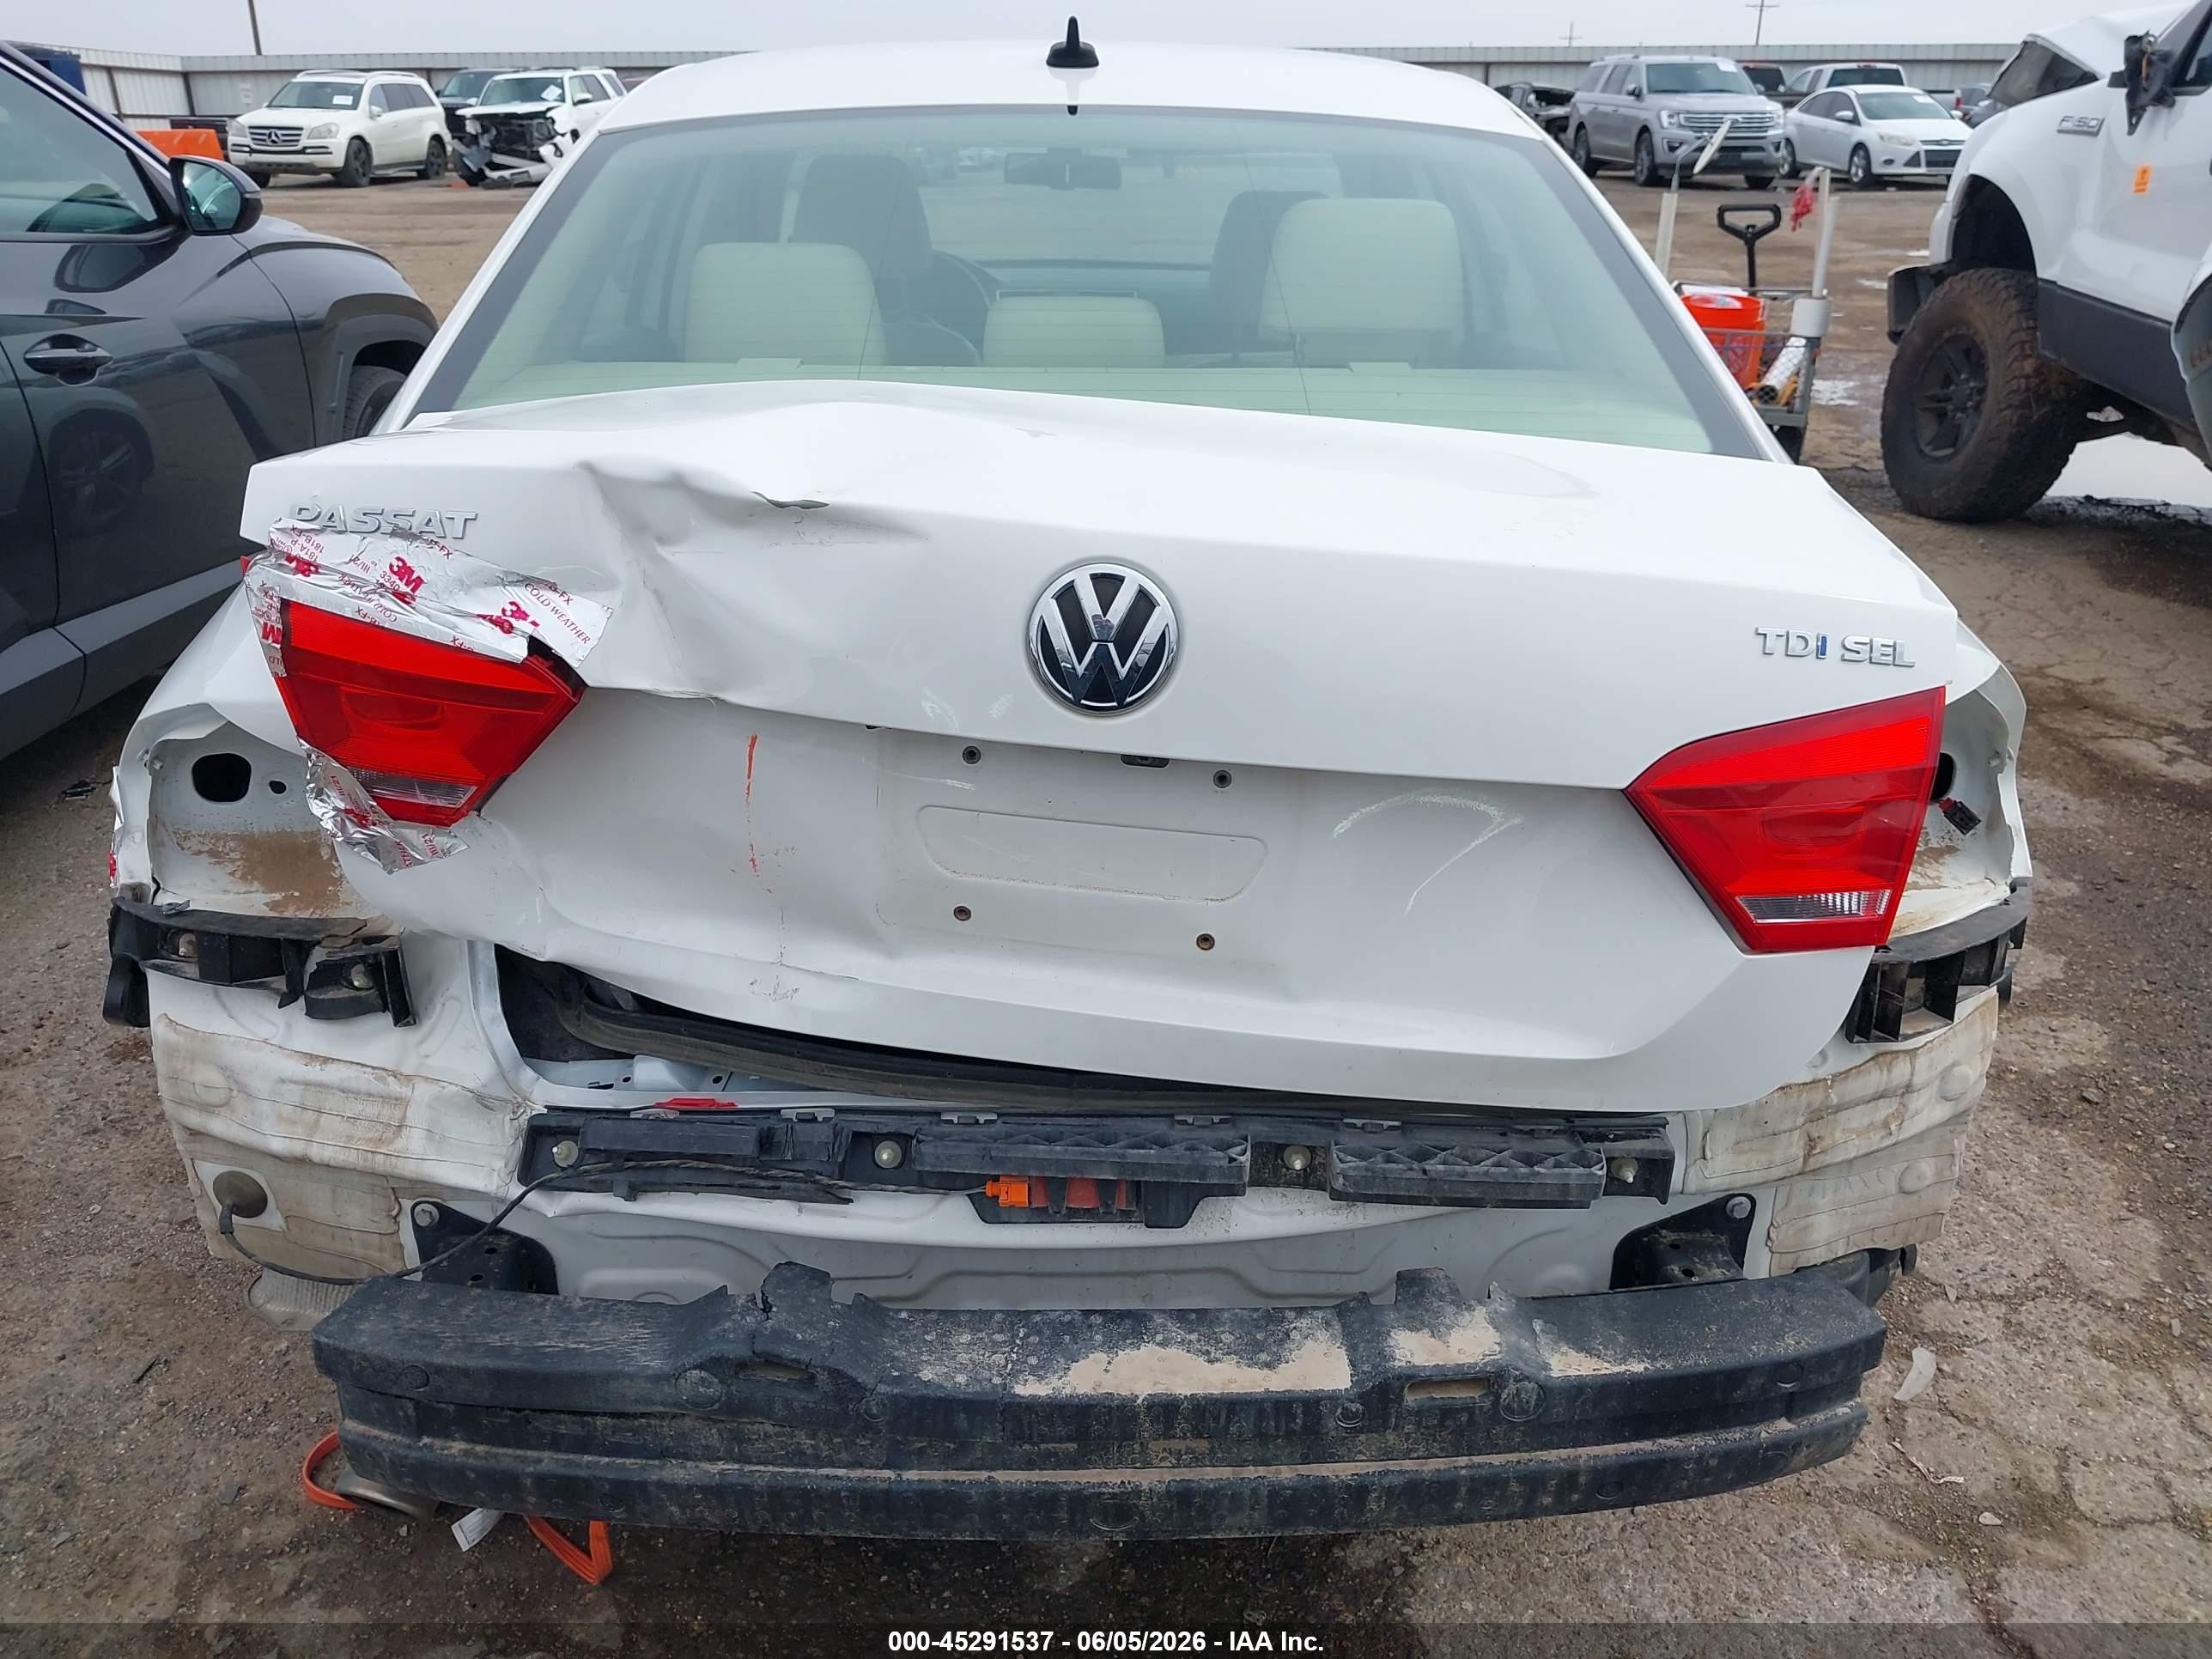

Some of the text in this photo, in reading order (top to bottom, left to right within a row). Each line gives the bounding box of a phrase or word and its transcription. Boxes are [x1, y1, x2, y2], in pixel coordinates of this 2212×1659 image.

[289, 502, 478, 539] PASSAT
[380, 570, 400, 592] 3340
[388, 556, 425, 594] 3M
[261, 621, 283, 645] M
[524, 583, 551, 607] COLD
[550, 605, 592, 645] WEATHER
[1030, 563, 1179, 715] VW
[1754, 627, 1916, 669] TDI SEL
